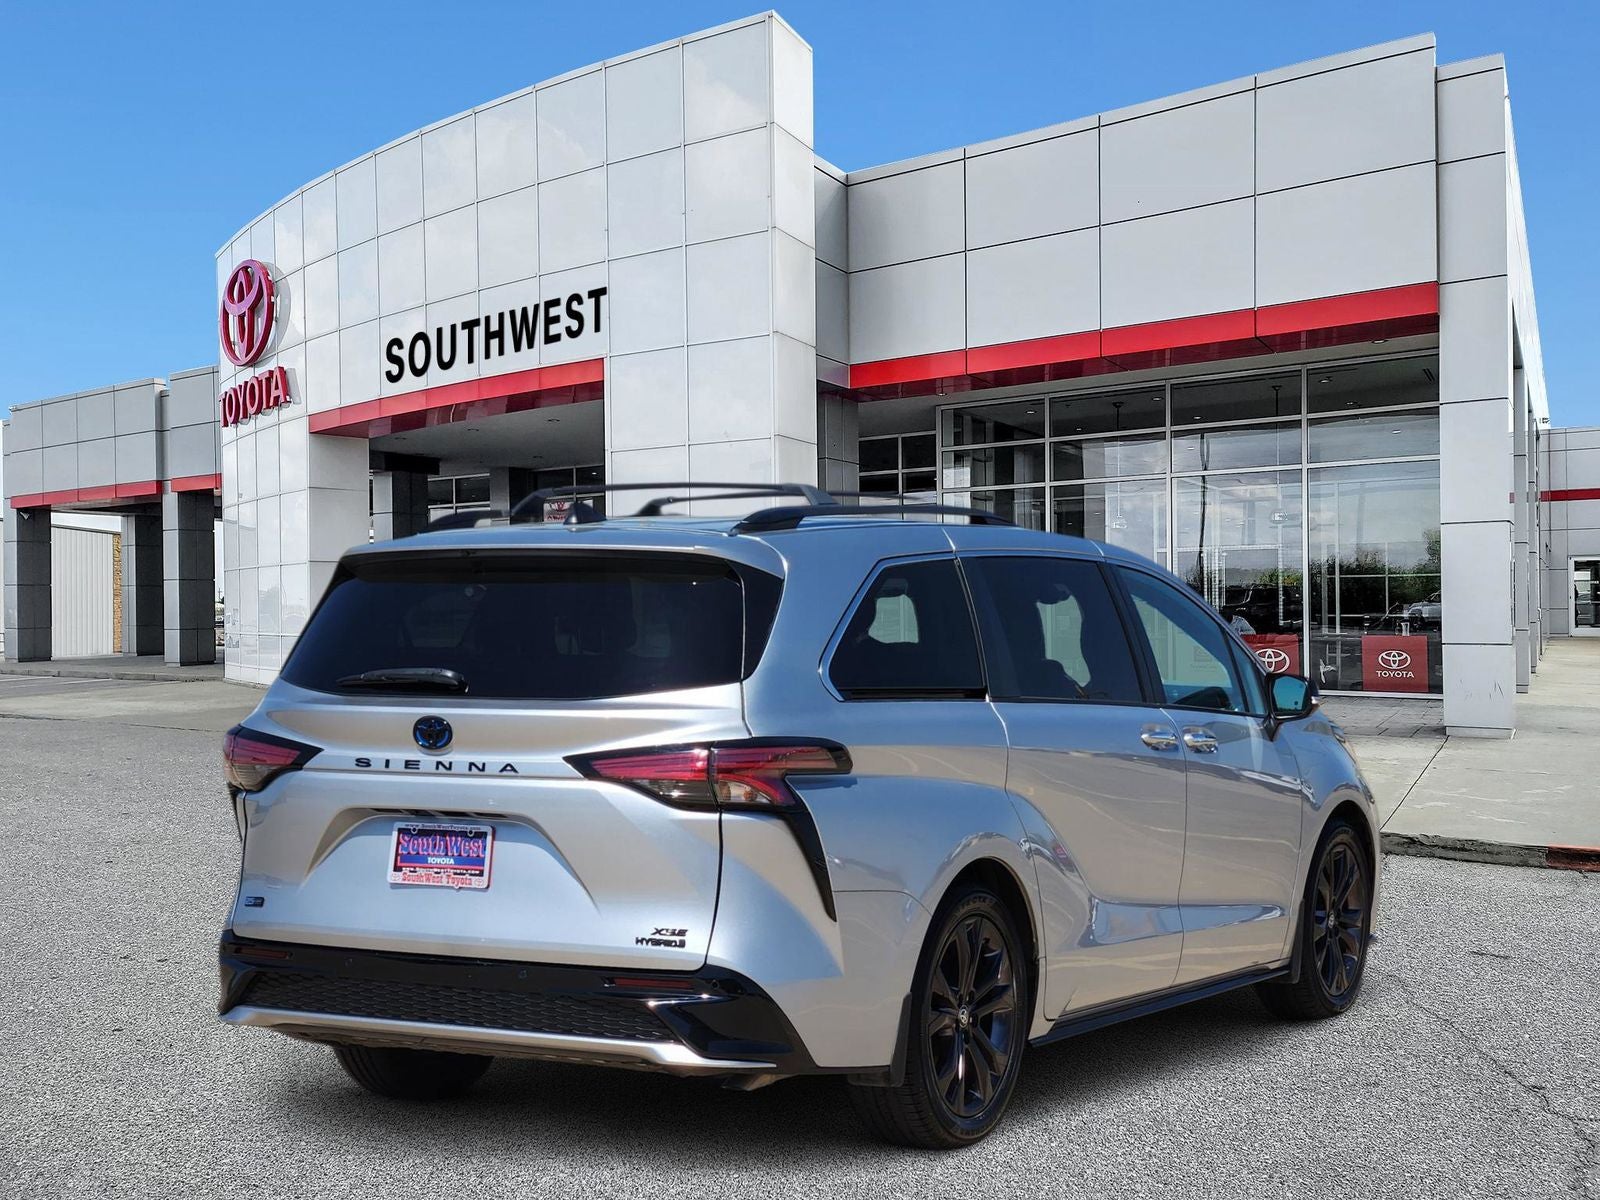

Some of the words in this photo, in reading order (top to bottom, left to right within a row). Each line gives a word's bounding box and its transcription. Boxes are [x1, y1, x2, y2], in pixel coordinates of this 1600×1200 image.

[385, 286, 608, 384] SOUTHWEST
[218, 366, 291, 427] TOYOTA
[1376, 670, 1414, 678] TOYOTA
[355, 758, 519, 773] SIENNA
[427, 857, 455, 865] TOYOTA
[446, 874, 473, 887] Toyota
[651, 928, 688, 936] XSE
